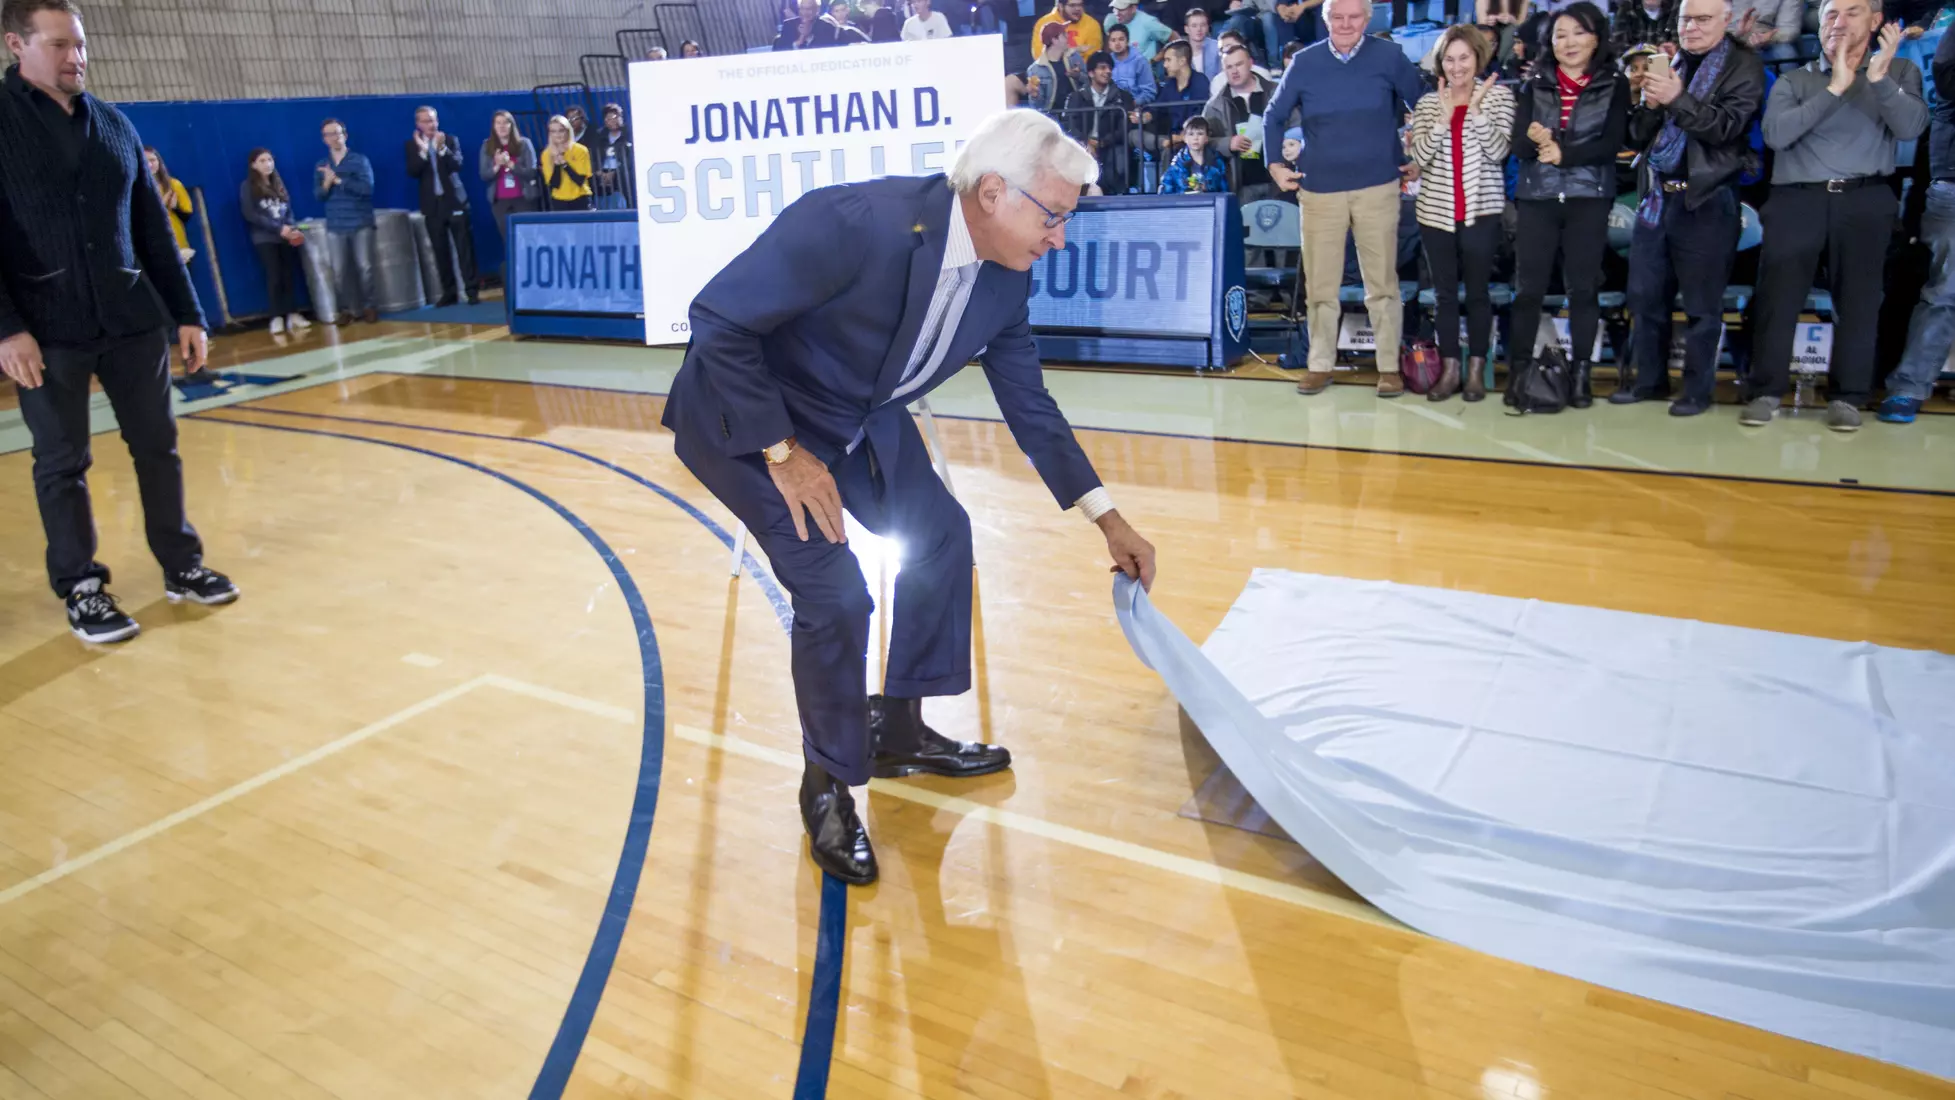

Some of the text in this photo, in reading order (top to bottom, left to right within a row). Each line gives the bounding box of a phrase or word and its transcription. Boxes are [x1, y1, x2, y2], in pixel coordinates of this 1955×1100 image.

[718, 54, 913, 80] THE OFFICIAL DEDICATION OF
[685, 86, 952, 145] JONATHAN D.
[647, 140, 964, 224] SCHI
